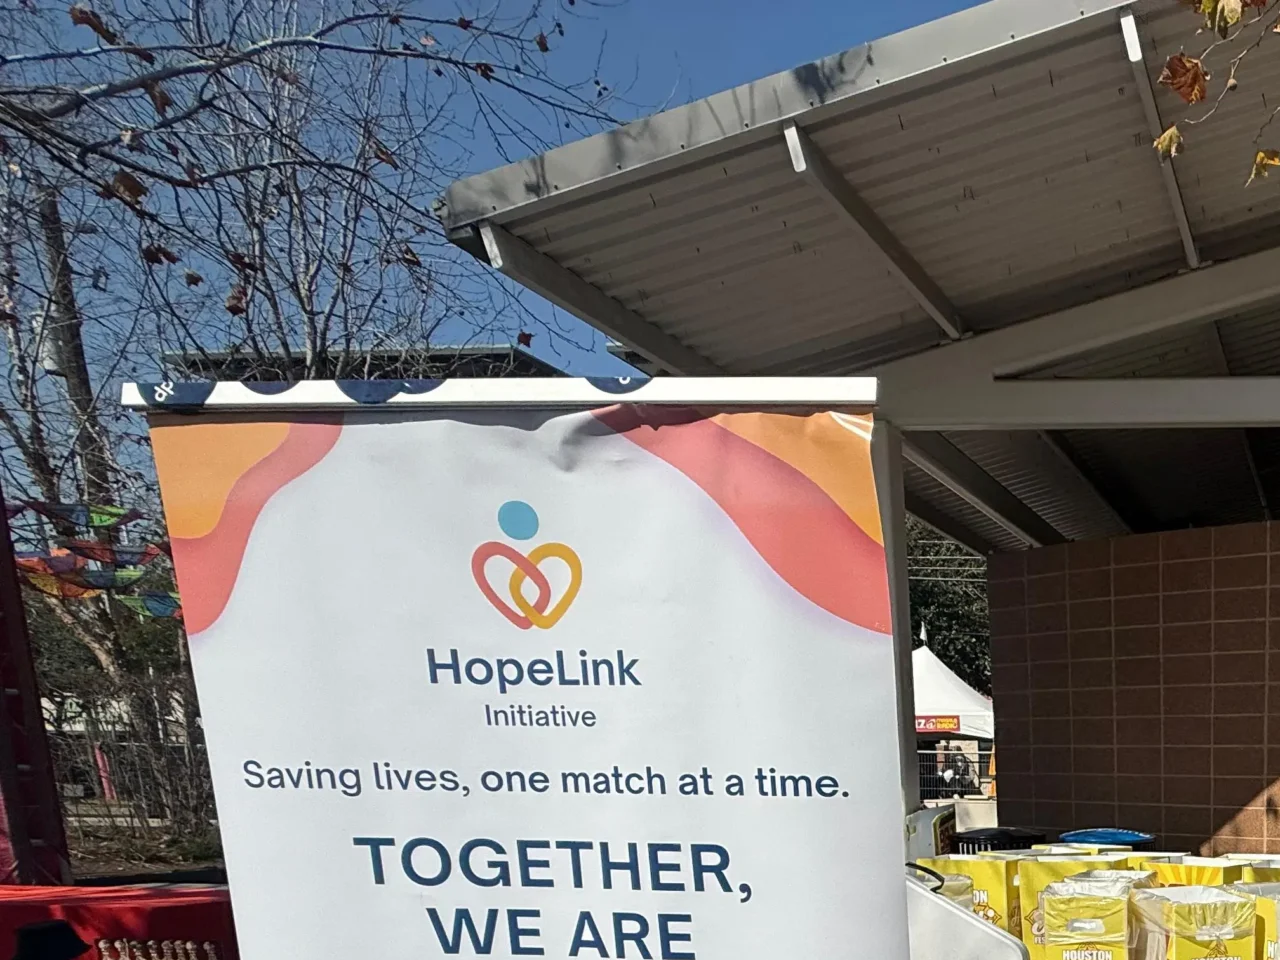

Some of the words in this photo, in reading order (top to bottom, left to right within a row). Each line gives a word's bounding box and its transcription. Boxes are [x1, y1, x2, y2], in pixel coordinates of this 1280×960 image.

[427, 649, 642, 694] HopeLink
[485, 704, 596, 727] Initiative
[243, 760, 361, 797] Saving
[373, 762, 470, 797] lives,
[481, 771, 549, 792] one
[561, 766, 666, 794] match
[679, 767, 714, 795] at
[725, 775, 744, 796] a
[755, 768, 849, 797] time.
[353, 837, 752, 903] TOGETHER,
[426, 908, 545, 956] WE
[568, 911, 696, 960] ARE
[1062, 950, 1112, 960] HOUSTON
